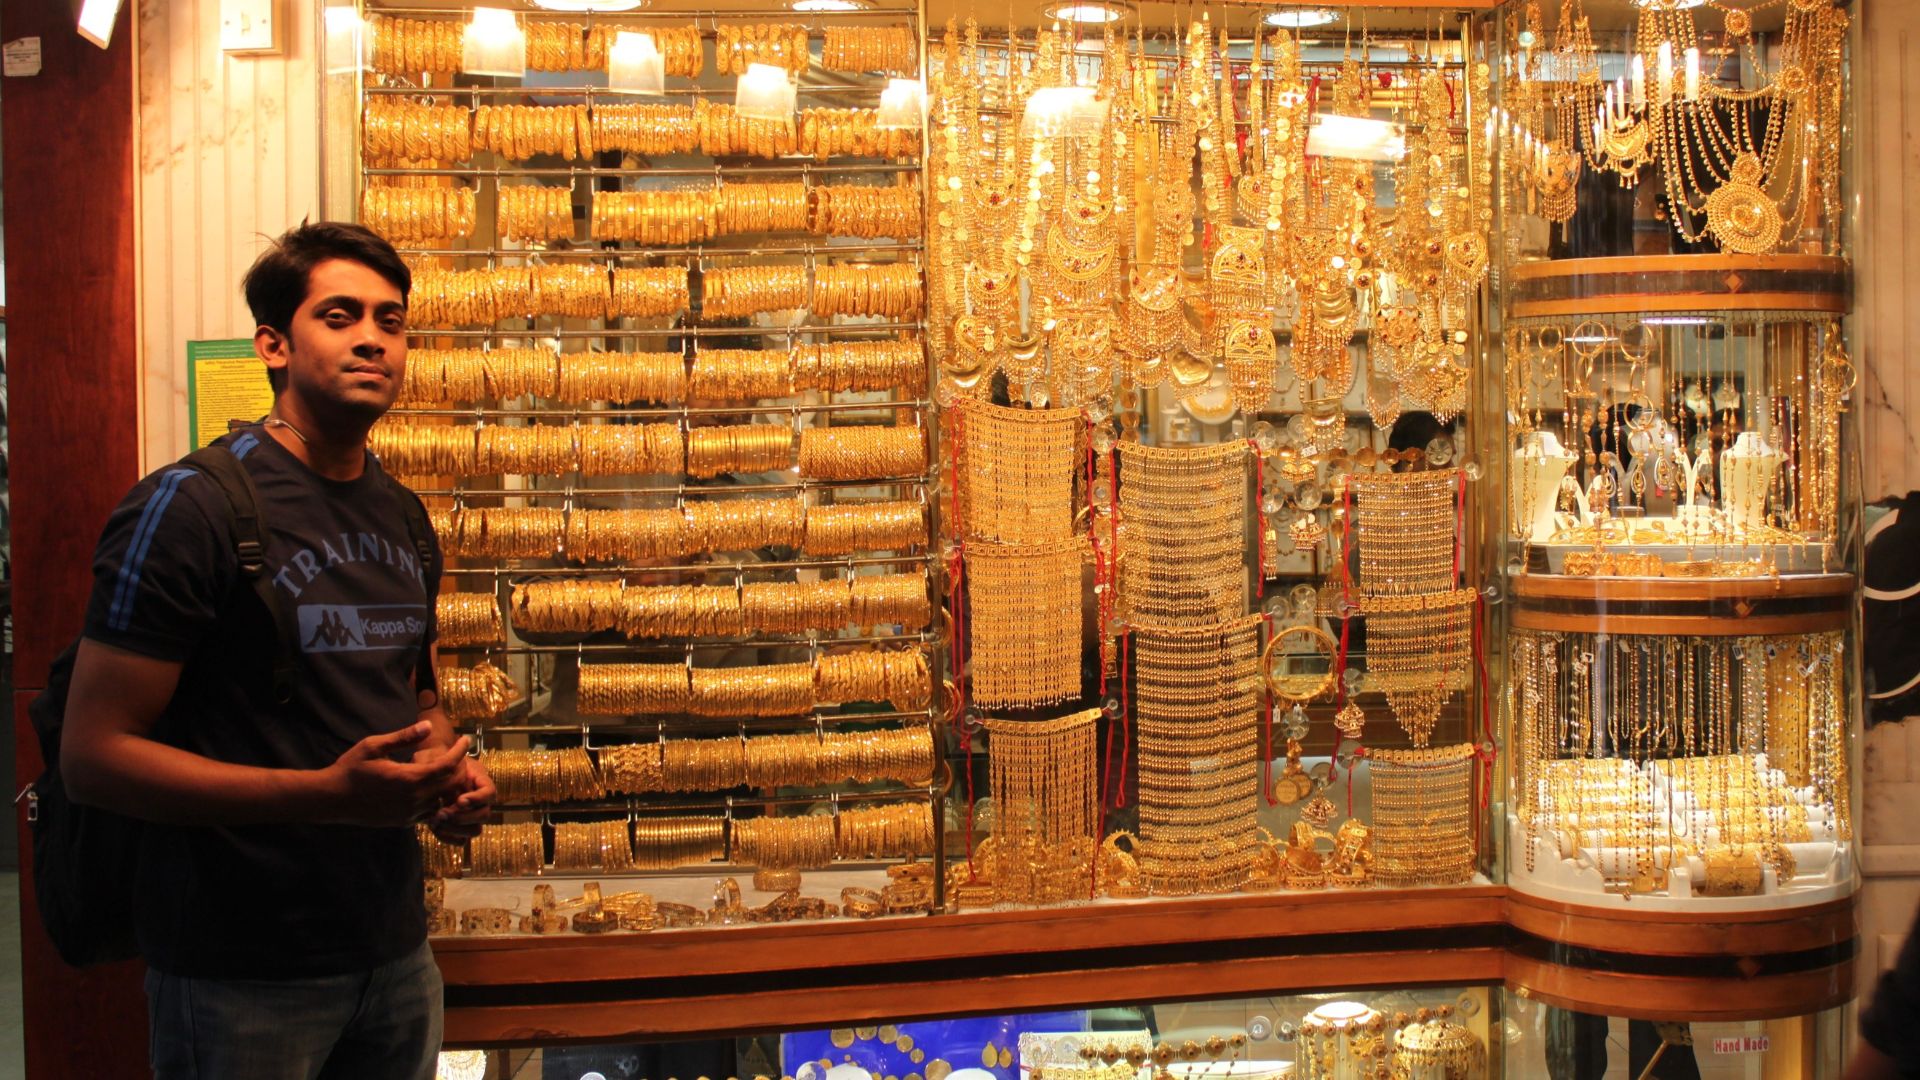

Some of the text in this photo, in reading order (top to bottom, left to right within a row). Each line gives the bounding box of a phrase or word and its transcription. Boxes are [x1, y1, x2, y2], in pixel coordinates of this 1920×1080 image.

[361, 619, 406, 639] Kappa
[1715, 1036, 1769, 1053] Hand Made
